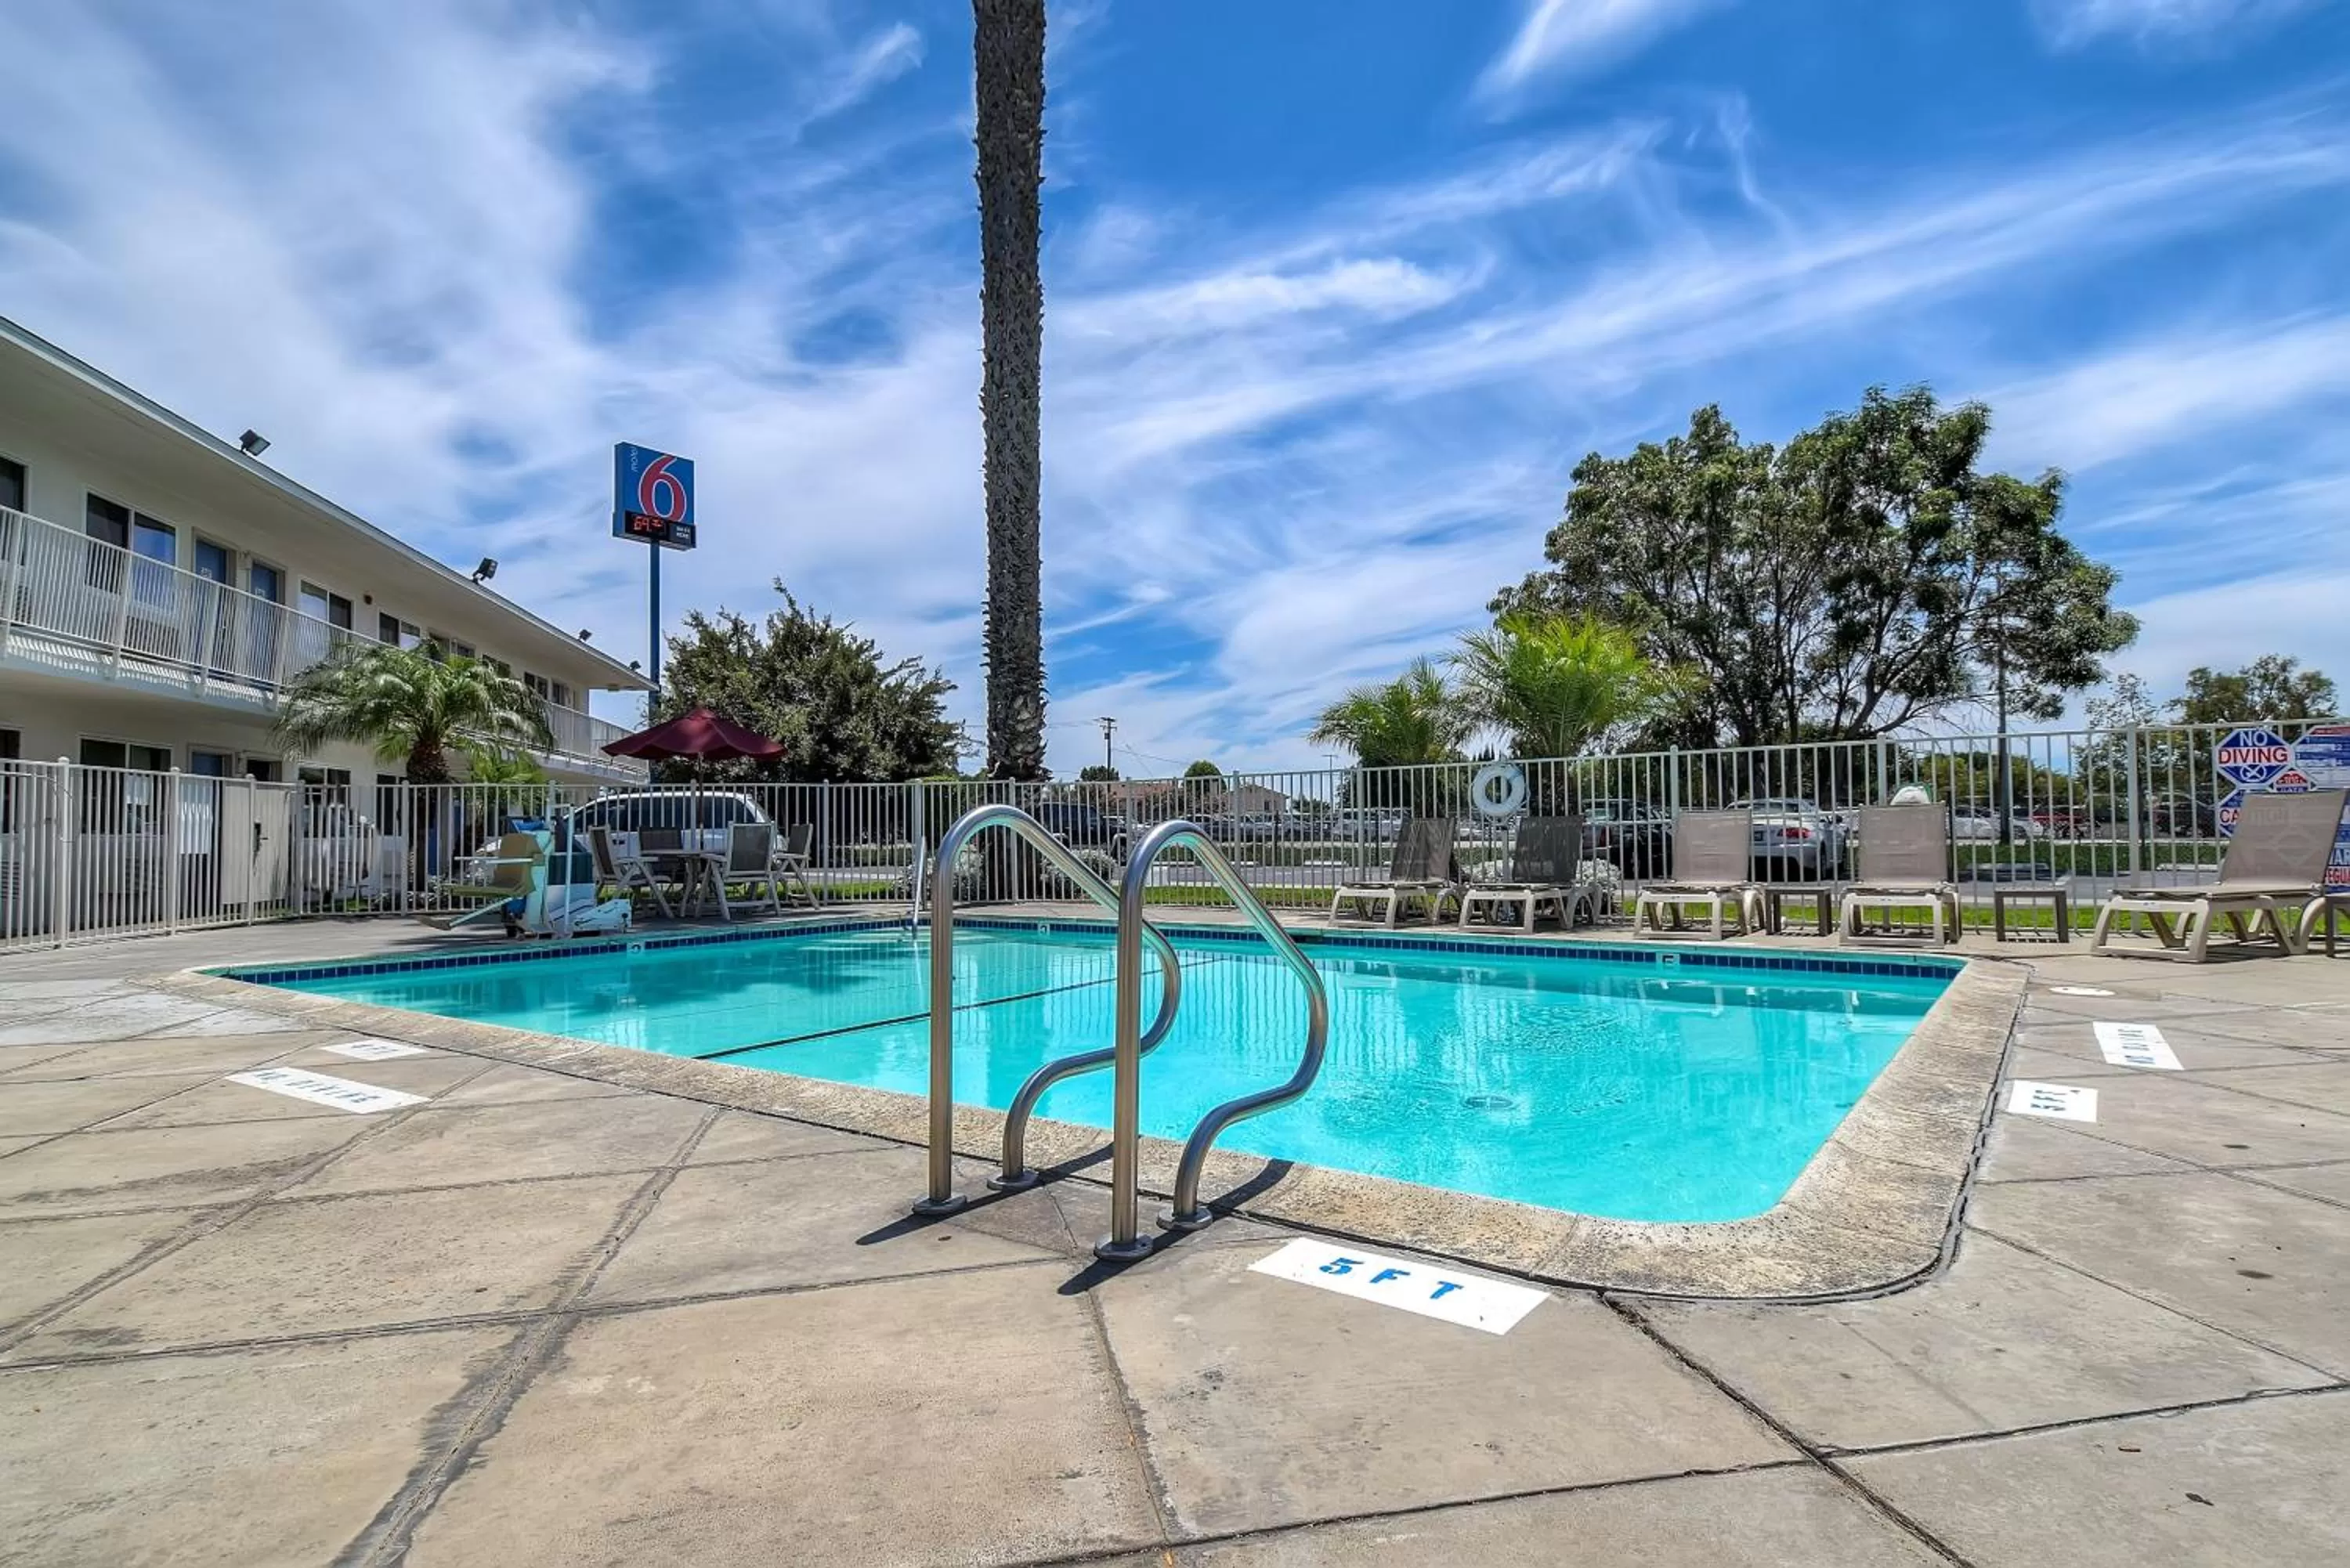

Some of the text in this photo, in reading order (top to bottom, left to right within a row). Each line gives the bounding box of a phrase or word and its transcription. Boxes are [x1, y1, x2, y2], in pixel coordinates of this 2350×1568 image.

[638, 455, 687, 522] 6
[2240, 730, 2268, 746] NO
[2218, 746, 2288, 764] DIVING
